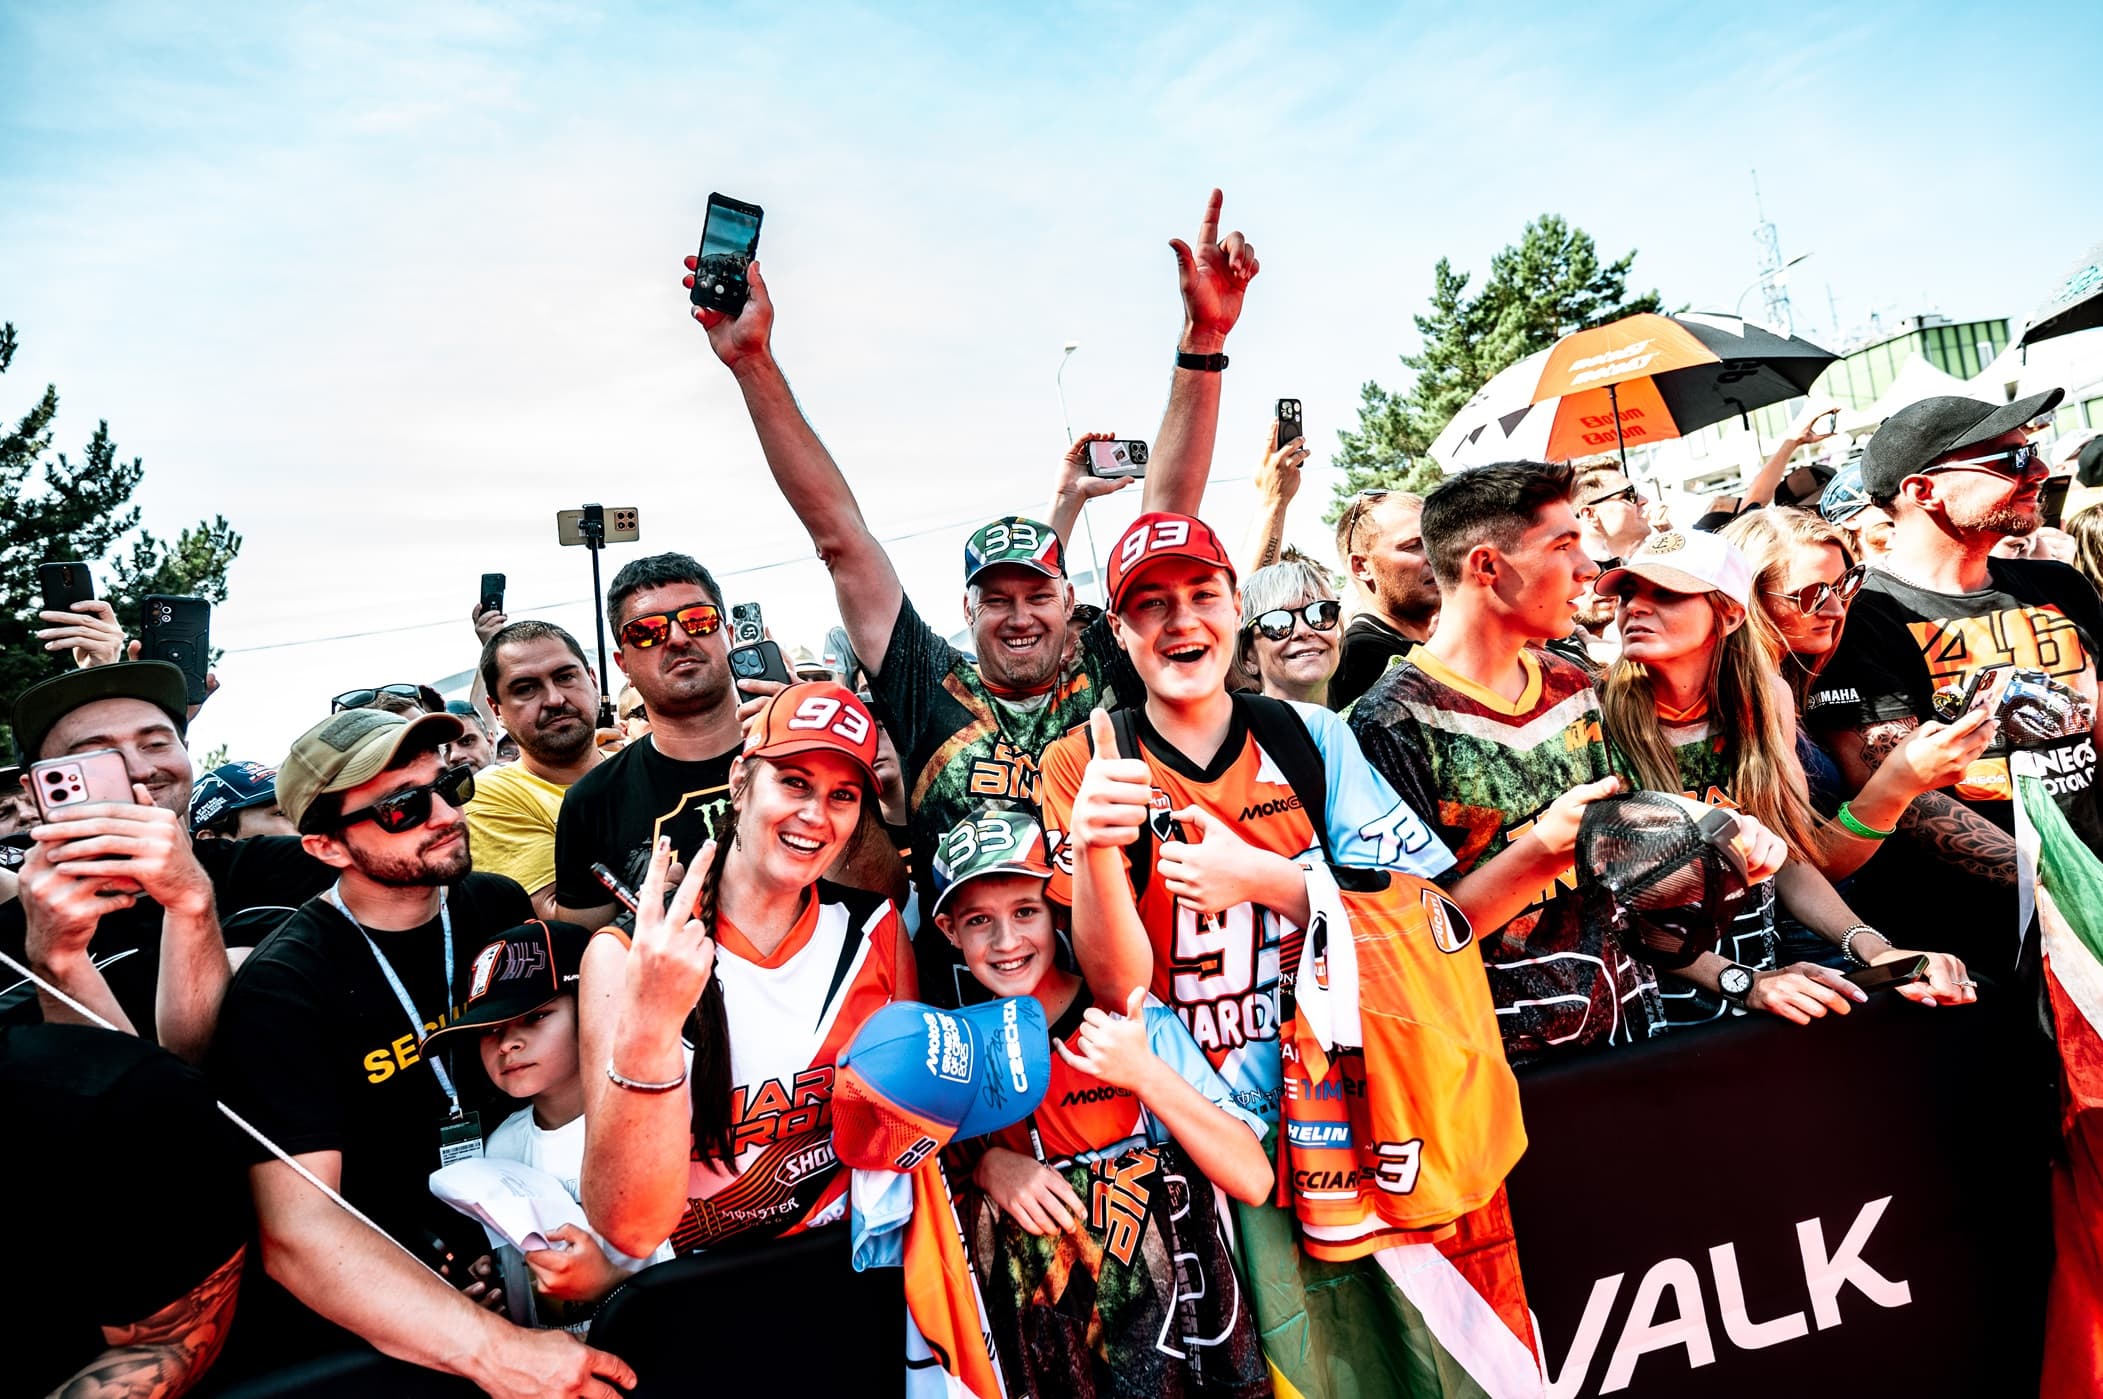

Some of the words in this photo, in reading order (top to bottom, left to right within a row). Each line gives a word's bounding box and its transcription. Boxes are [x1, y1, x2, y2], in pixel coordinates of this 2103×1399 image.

[984, 523, 1040, 552] 33
[1119, 520, 1190, 573] 93
[1921, 611, 2087, 690] 46
[788, 697, 870, 746] 93
[1238, 795, 1302, 822] MotoG
[2042, 771, 2090, 796] OTOR
[948, 818, 1016, 868] 33
[1358, 799, 1433, 866] 73
[1178, 988, 1280, 1049] ARQ
[1003, 999, 1029, 1093] CZECHIA
[733, 1102, 835, 1157] RQ
[893, 1135, 939, 1169] 25
[722, 1197, 800, 1221] MONSTER
